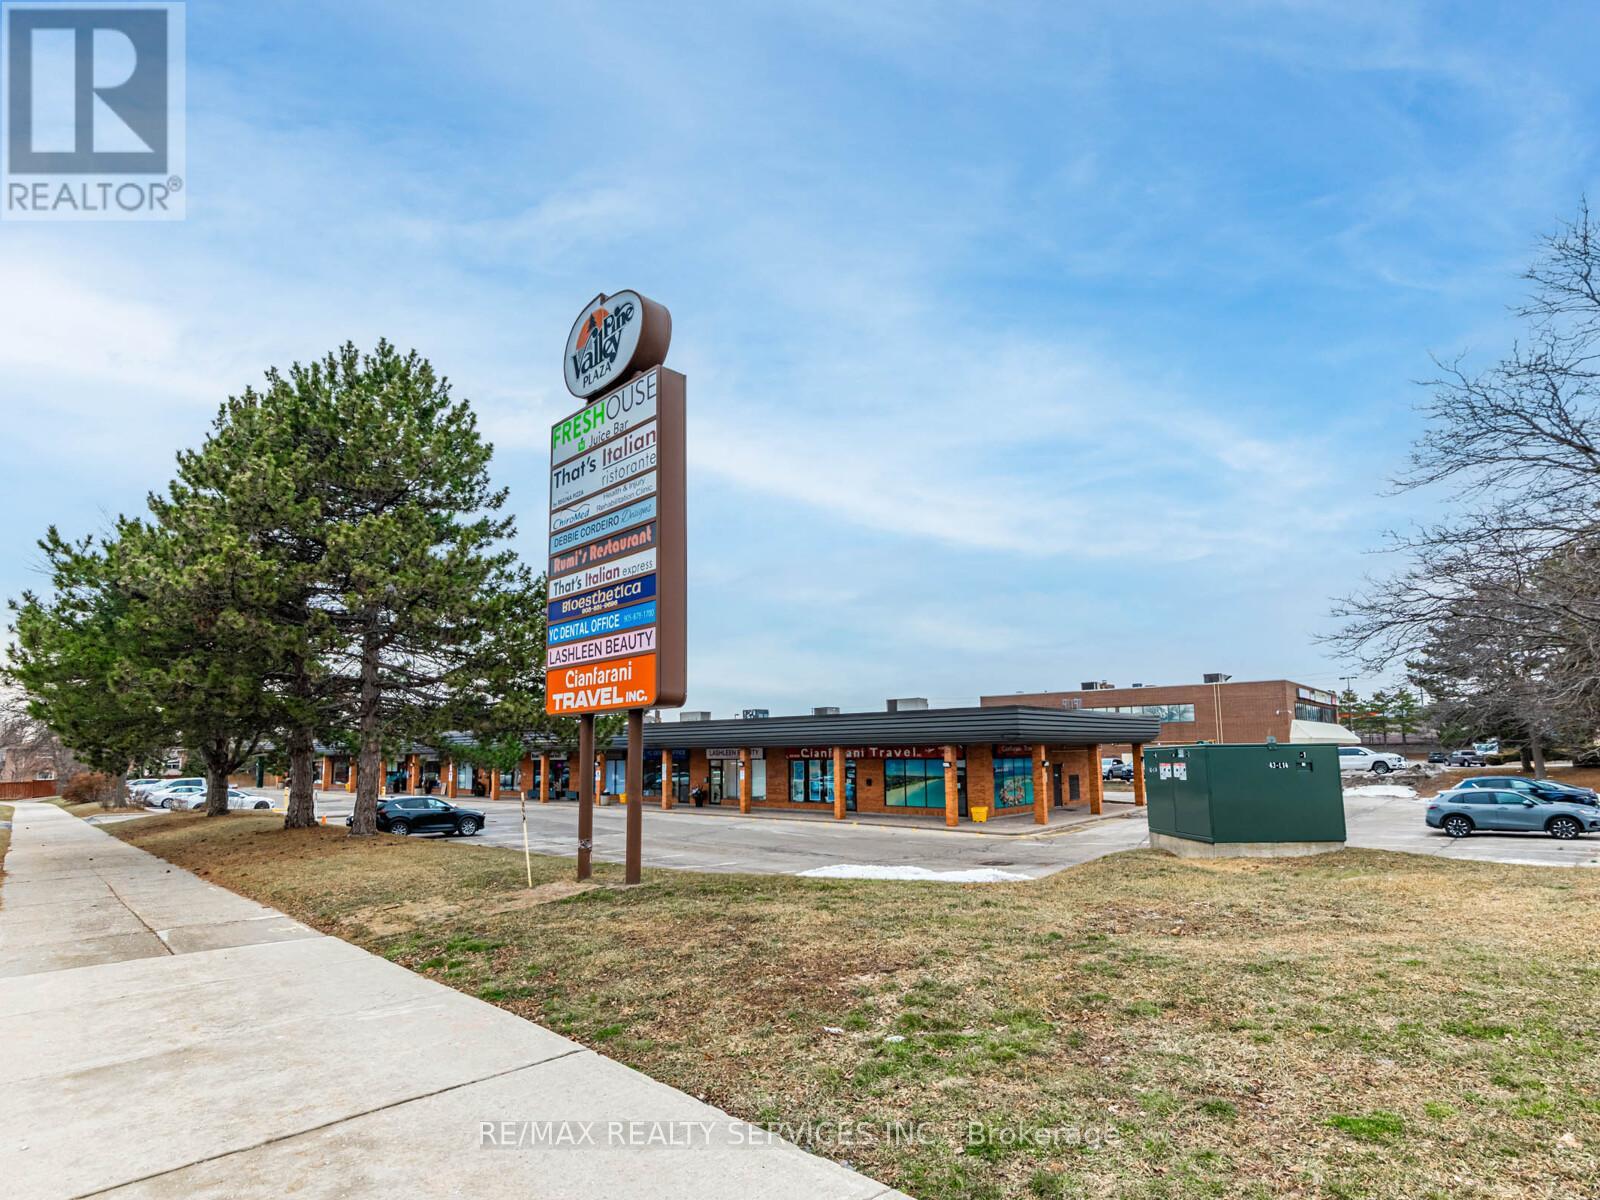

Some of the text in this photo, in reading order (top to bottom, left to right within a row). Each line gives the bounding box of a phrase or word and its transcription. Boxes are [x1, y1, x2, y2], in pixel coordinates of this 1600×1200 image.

[603, 303, 635, 338] Pine
[572, 327, 622, 379] Valley
[583, 362, 612, 388] PLAZA
[589, 420, 628, 448] Juice Bar
[554, 430, 657, 489] That's Italian
[601, 452, 657, 486] ristorante
[554, 530, 579, 548] DEBBIE
[580, 515, 620, 538] CORDEIRO
[589, 525, 652, 561] Restaurant
[553, 560, 653, 596] That's Italian express
[562, 582, 642, 613] Bioesthetica
[549, 627, 559, 641] YC
[560, 621, 589, 638] DENTAL
[590, 613, 620, 632] OFFICE
[549, 630, 653, 665] LASHLEEN BEAUTY
[565, 661, 633, 688] Cianfarani
[552, 686, 648, 711] TRAVEL INC.
[800, 747, 865, 758] Cianfani
